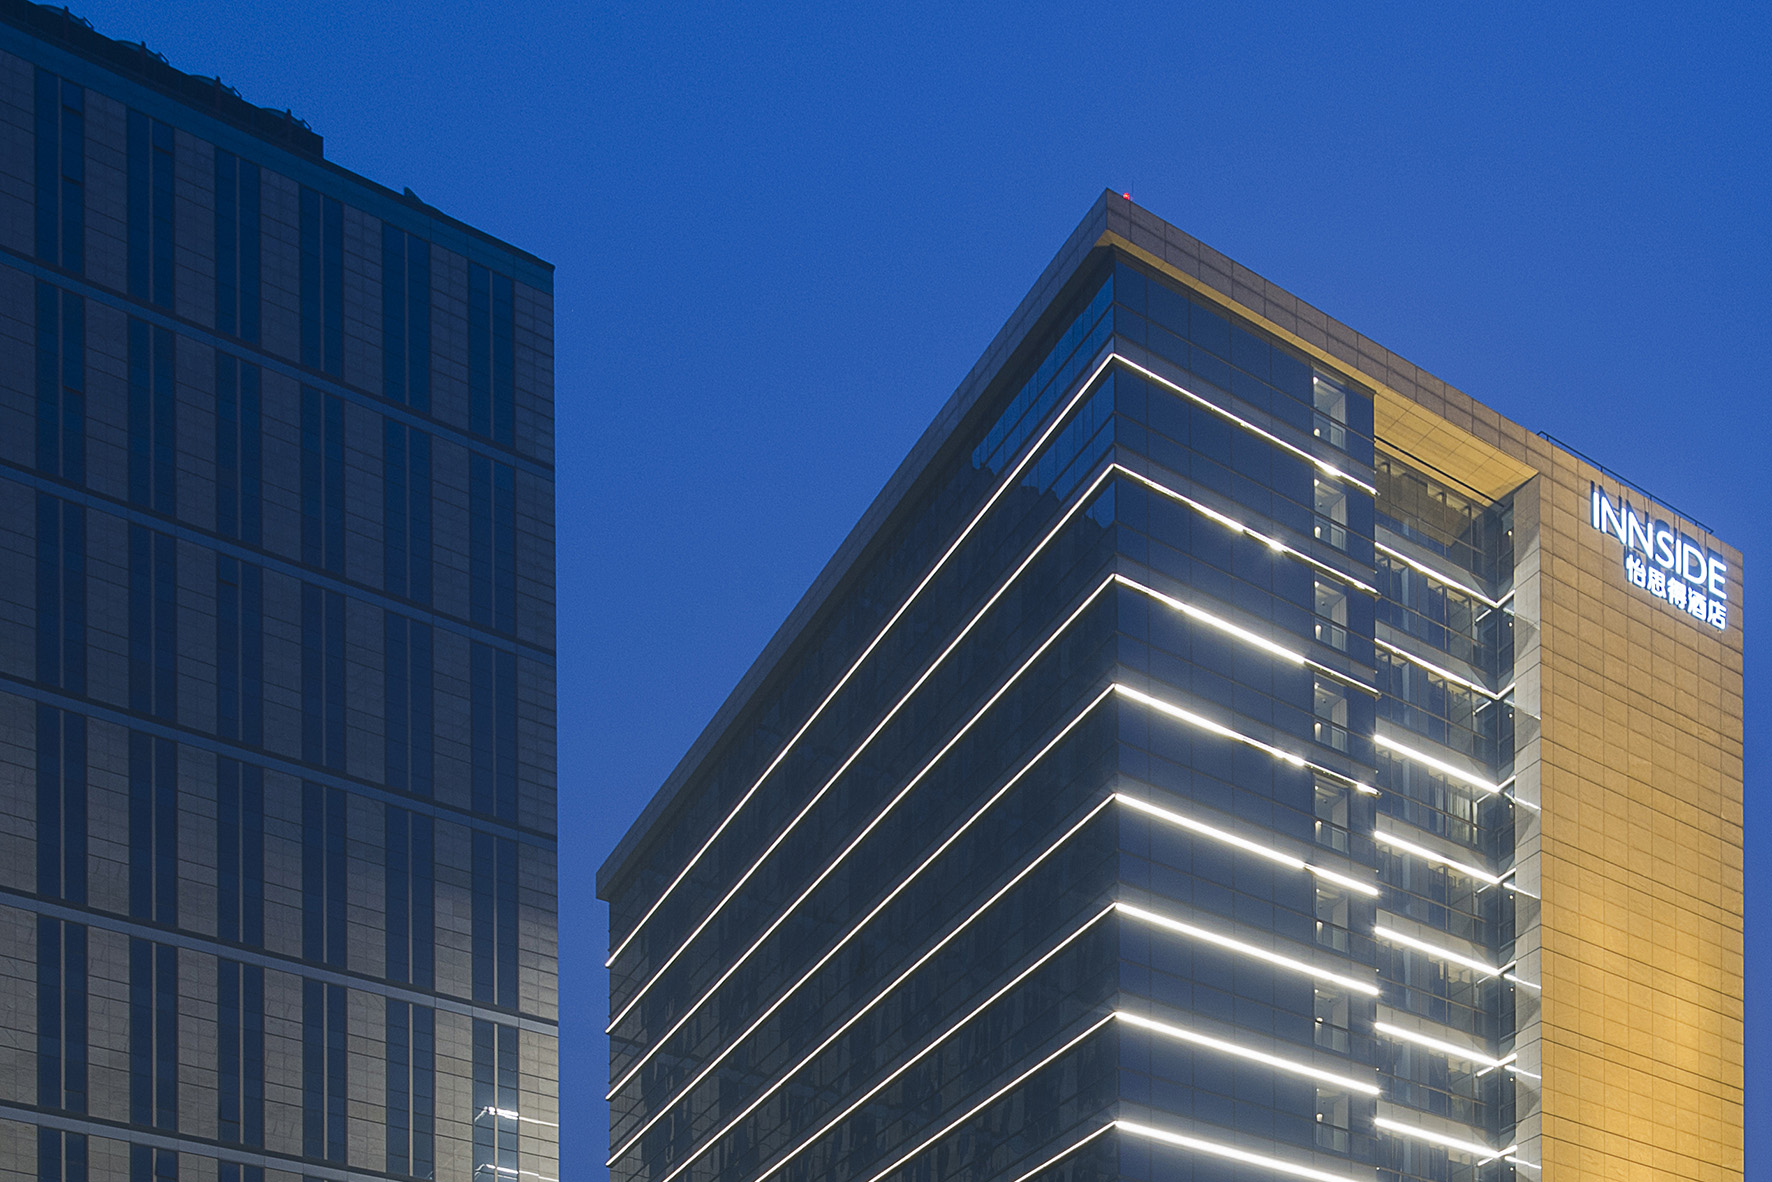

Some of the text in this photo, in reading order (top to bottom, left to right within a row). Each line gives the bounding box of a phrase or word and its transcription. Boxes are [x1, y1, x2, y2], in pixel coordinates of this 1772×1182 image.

[1593, 491, 1727, 600] INNSIDE
[1626, 554, 1727, 630] 怡思得酒店
